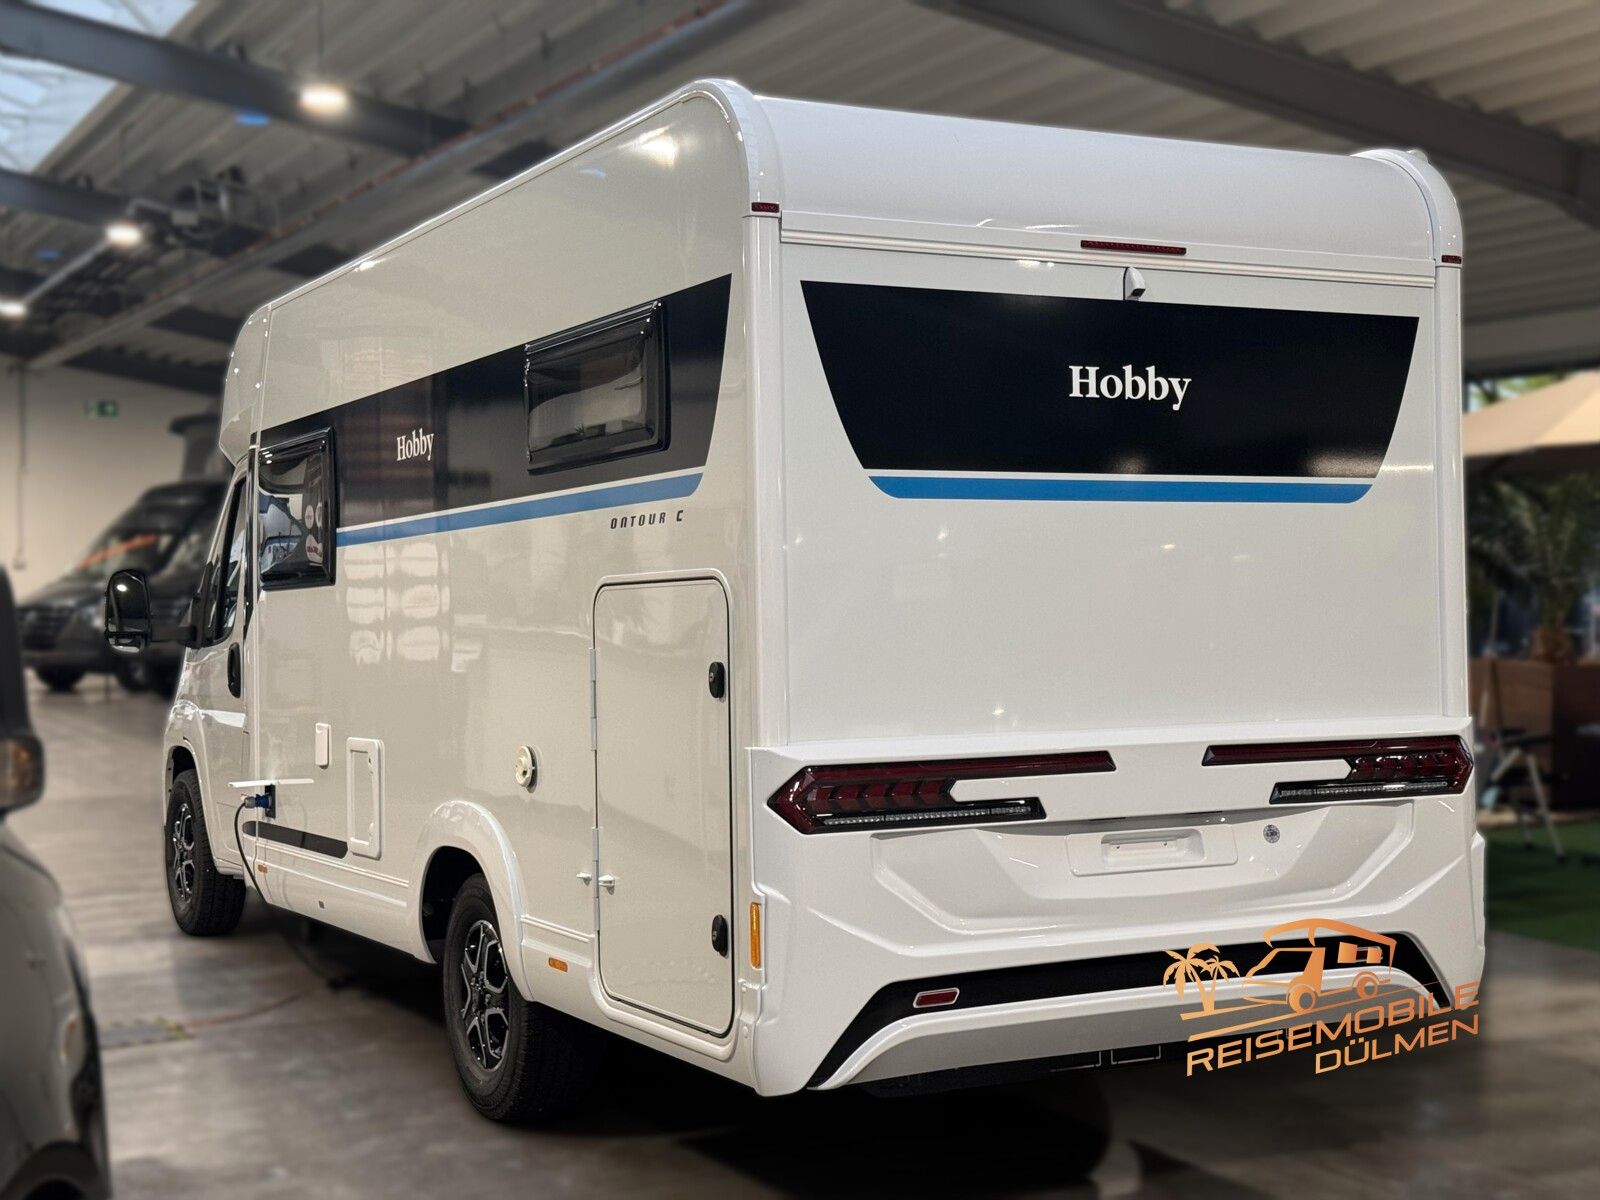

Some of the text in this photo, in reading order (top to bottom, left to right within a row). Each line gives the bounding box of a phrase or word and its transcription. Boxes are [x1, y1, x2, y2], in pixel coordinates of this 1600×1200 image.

[1068, 364, 1192, 411] Hobby
[396, 427, 435, 462] Hobby
[610, 509, 684, 529] ONTOUR C
